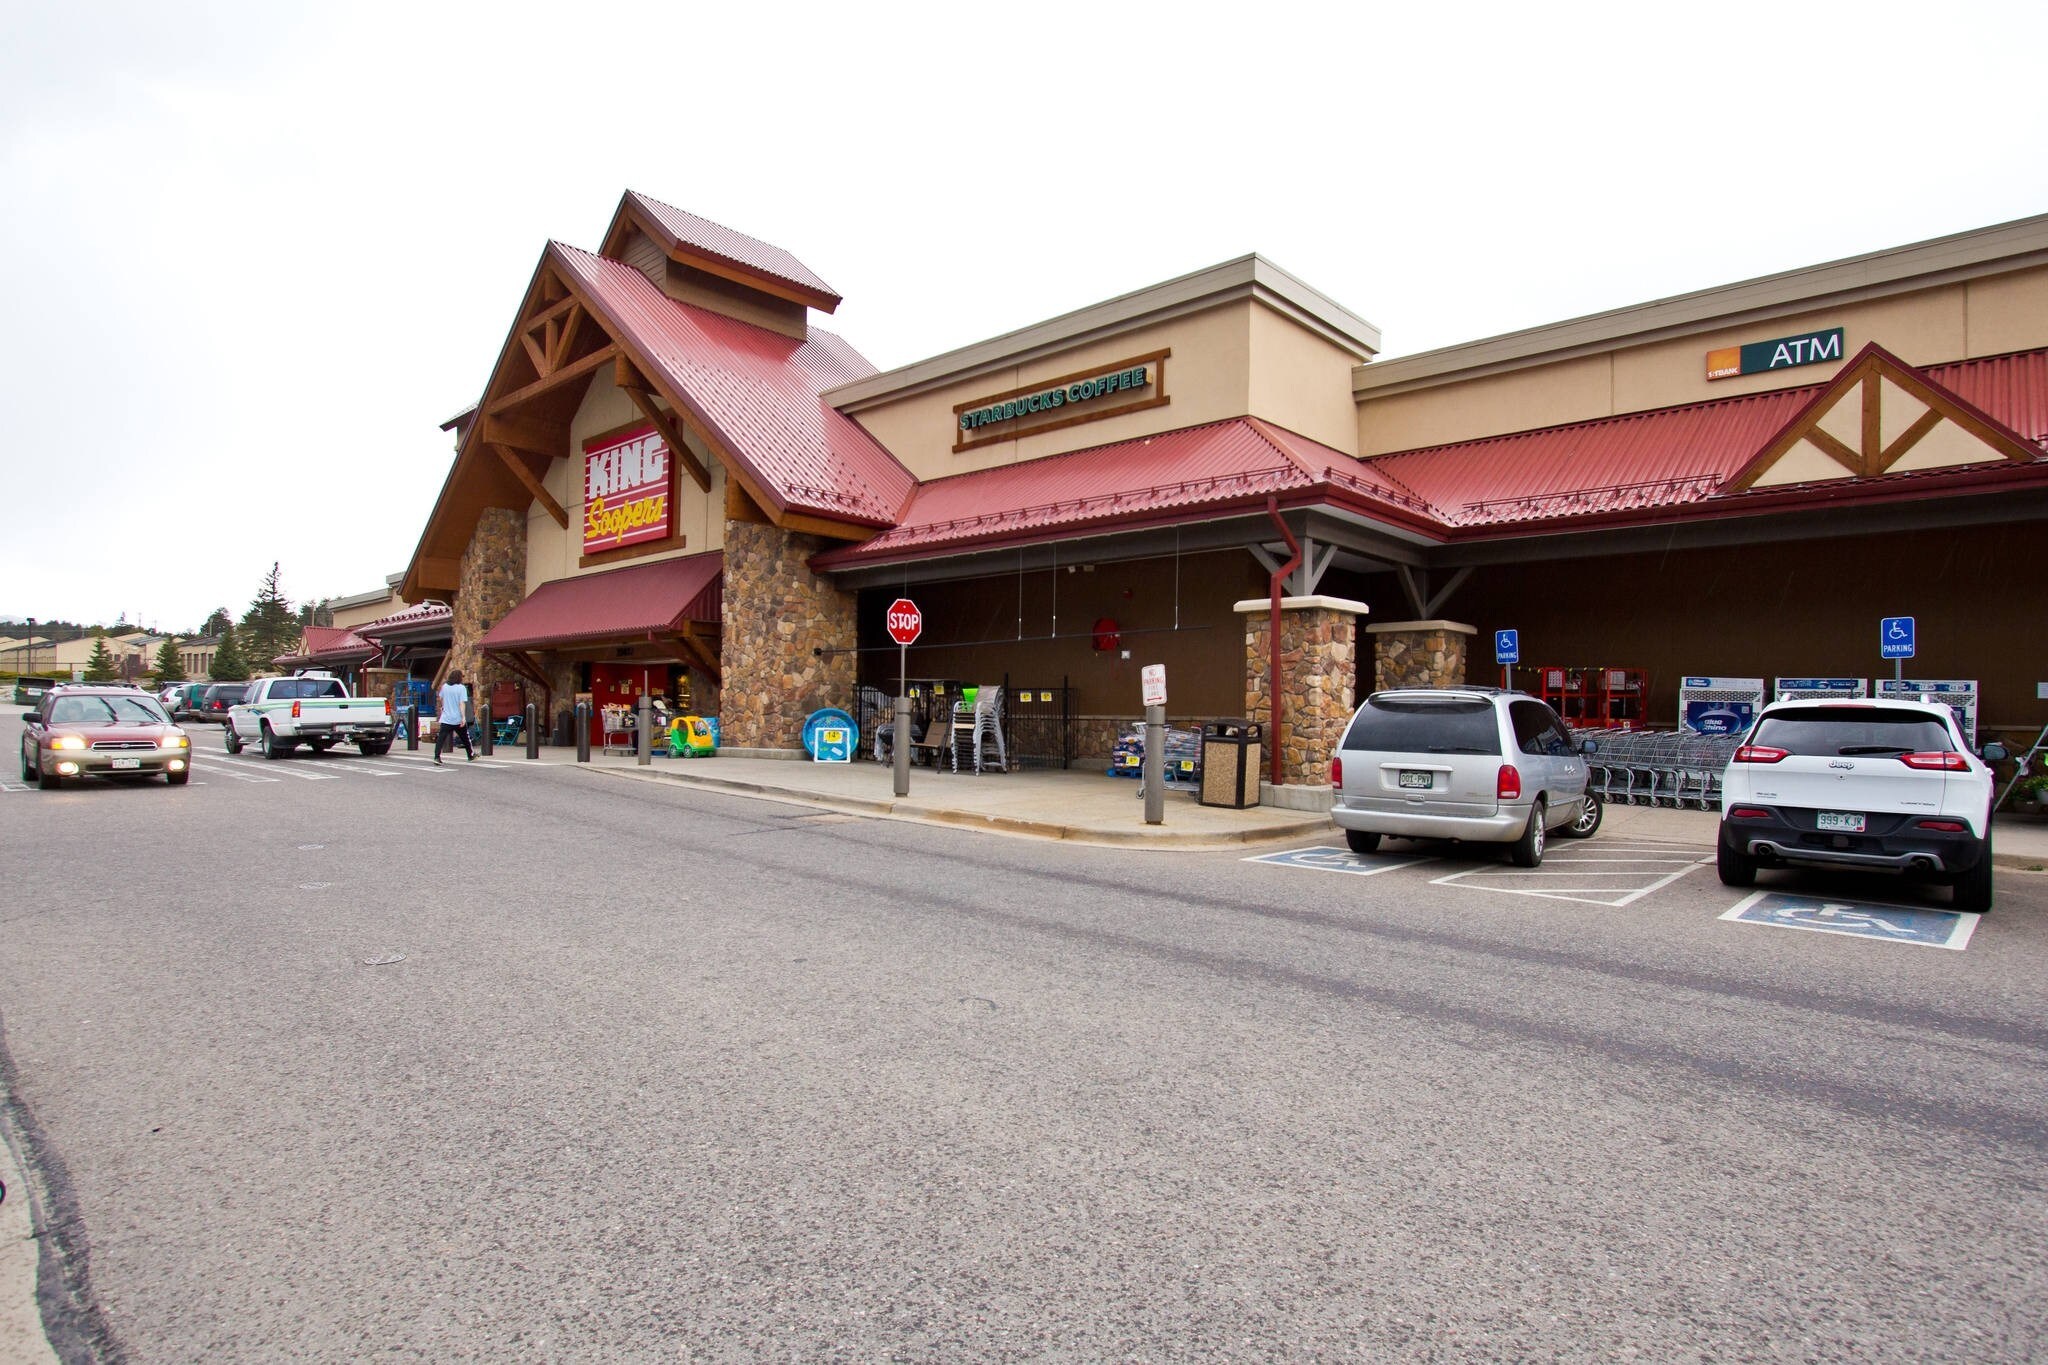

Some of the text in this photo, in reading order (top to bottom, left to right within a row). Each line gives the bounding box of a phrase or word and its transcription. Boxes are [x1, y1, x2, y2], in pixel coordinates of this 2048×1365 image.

[1769, 334, 1840, 368] ATM
[960, 367, 1146, 431] STARBUCKS COFFEE
[589, 434, 664, 499] KING
[586, 495, 664, 544] Soopers
[890, 612, 919, 630] STOP
[1883, 644, 1913, 653] PARKING
[1828, 760, 1855, 770] Jeep
